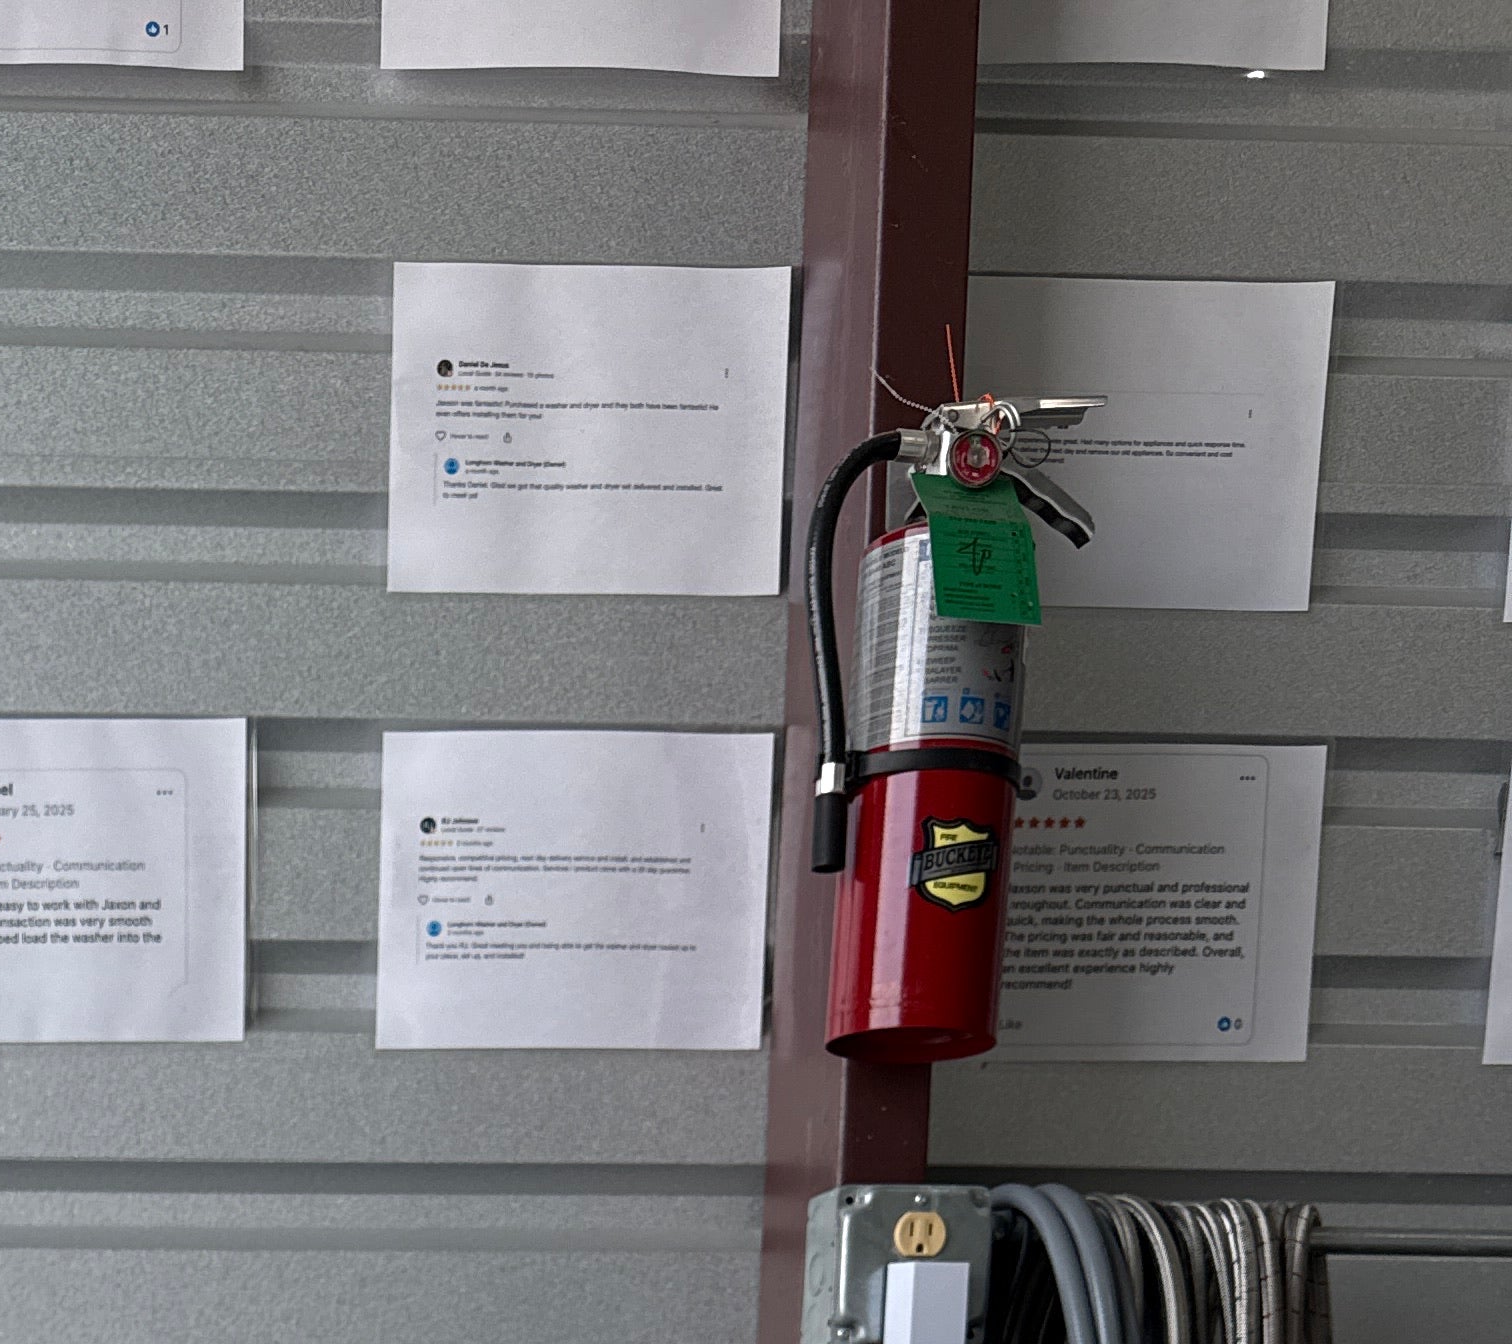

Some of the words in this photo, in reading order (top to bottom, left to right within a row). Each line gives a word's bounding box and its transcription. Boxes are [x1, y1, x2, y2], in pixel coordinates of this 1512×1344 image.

[163, 24, 170, 36] 1
[1055, 767, 1119, 781] Valentine
[1053, 788, 1101, 801] October
[1126, 788, 1158, 800] 2025
[1059, 843, 1126, 857] Punctuality
[1136, 842, 1226, 855] Communication
[53, 861, 146, 873] Communication
[1092, 861, 1160, 874] Description
[11, 878, 80, 892] Description
[1049, 884, 1072, 894] was
[1075, 884, 1101, 897] very
[1103, 881, 1154, 896] punctual
[1157, 881, 1179, 894] and
[1181, 880, 1250, 895] professional
[50, 933, 70, 944] the
[142, 933, 163, 945] the
